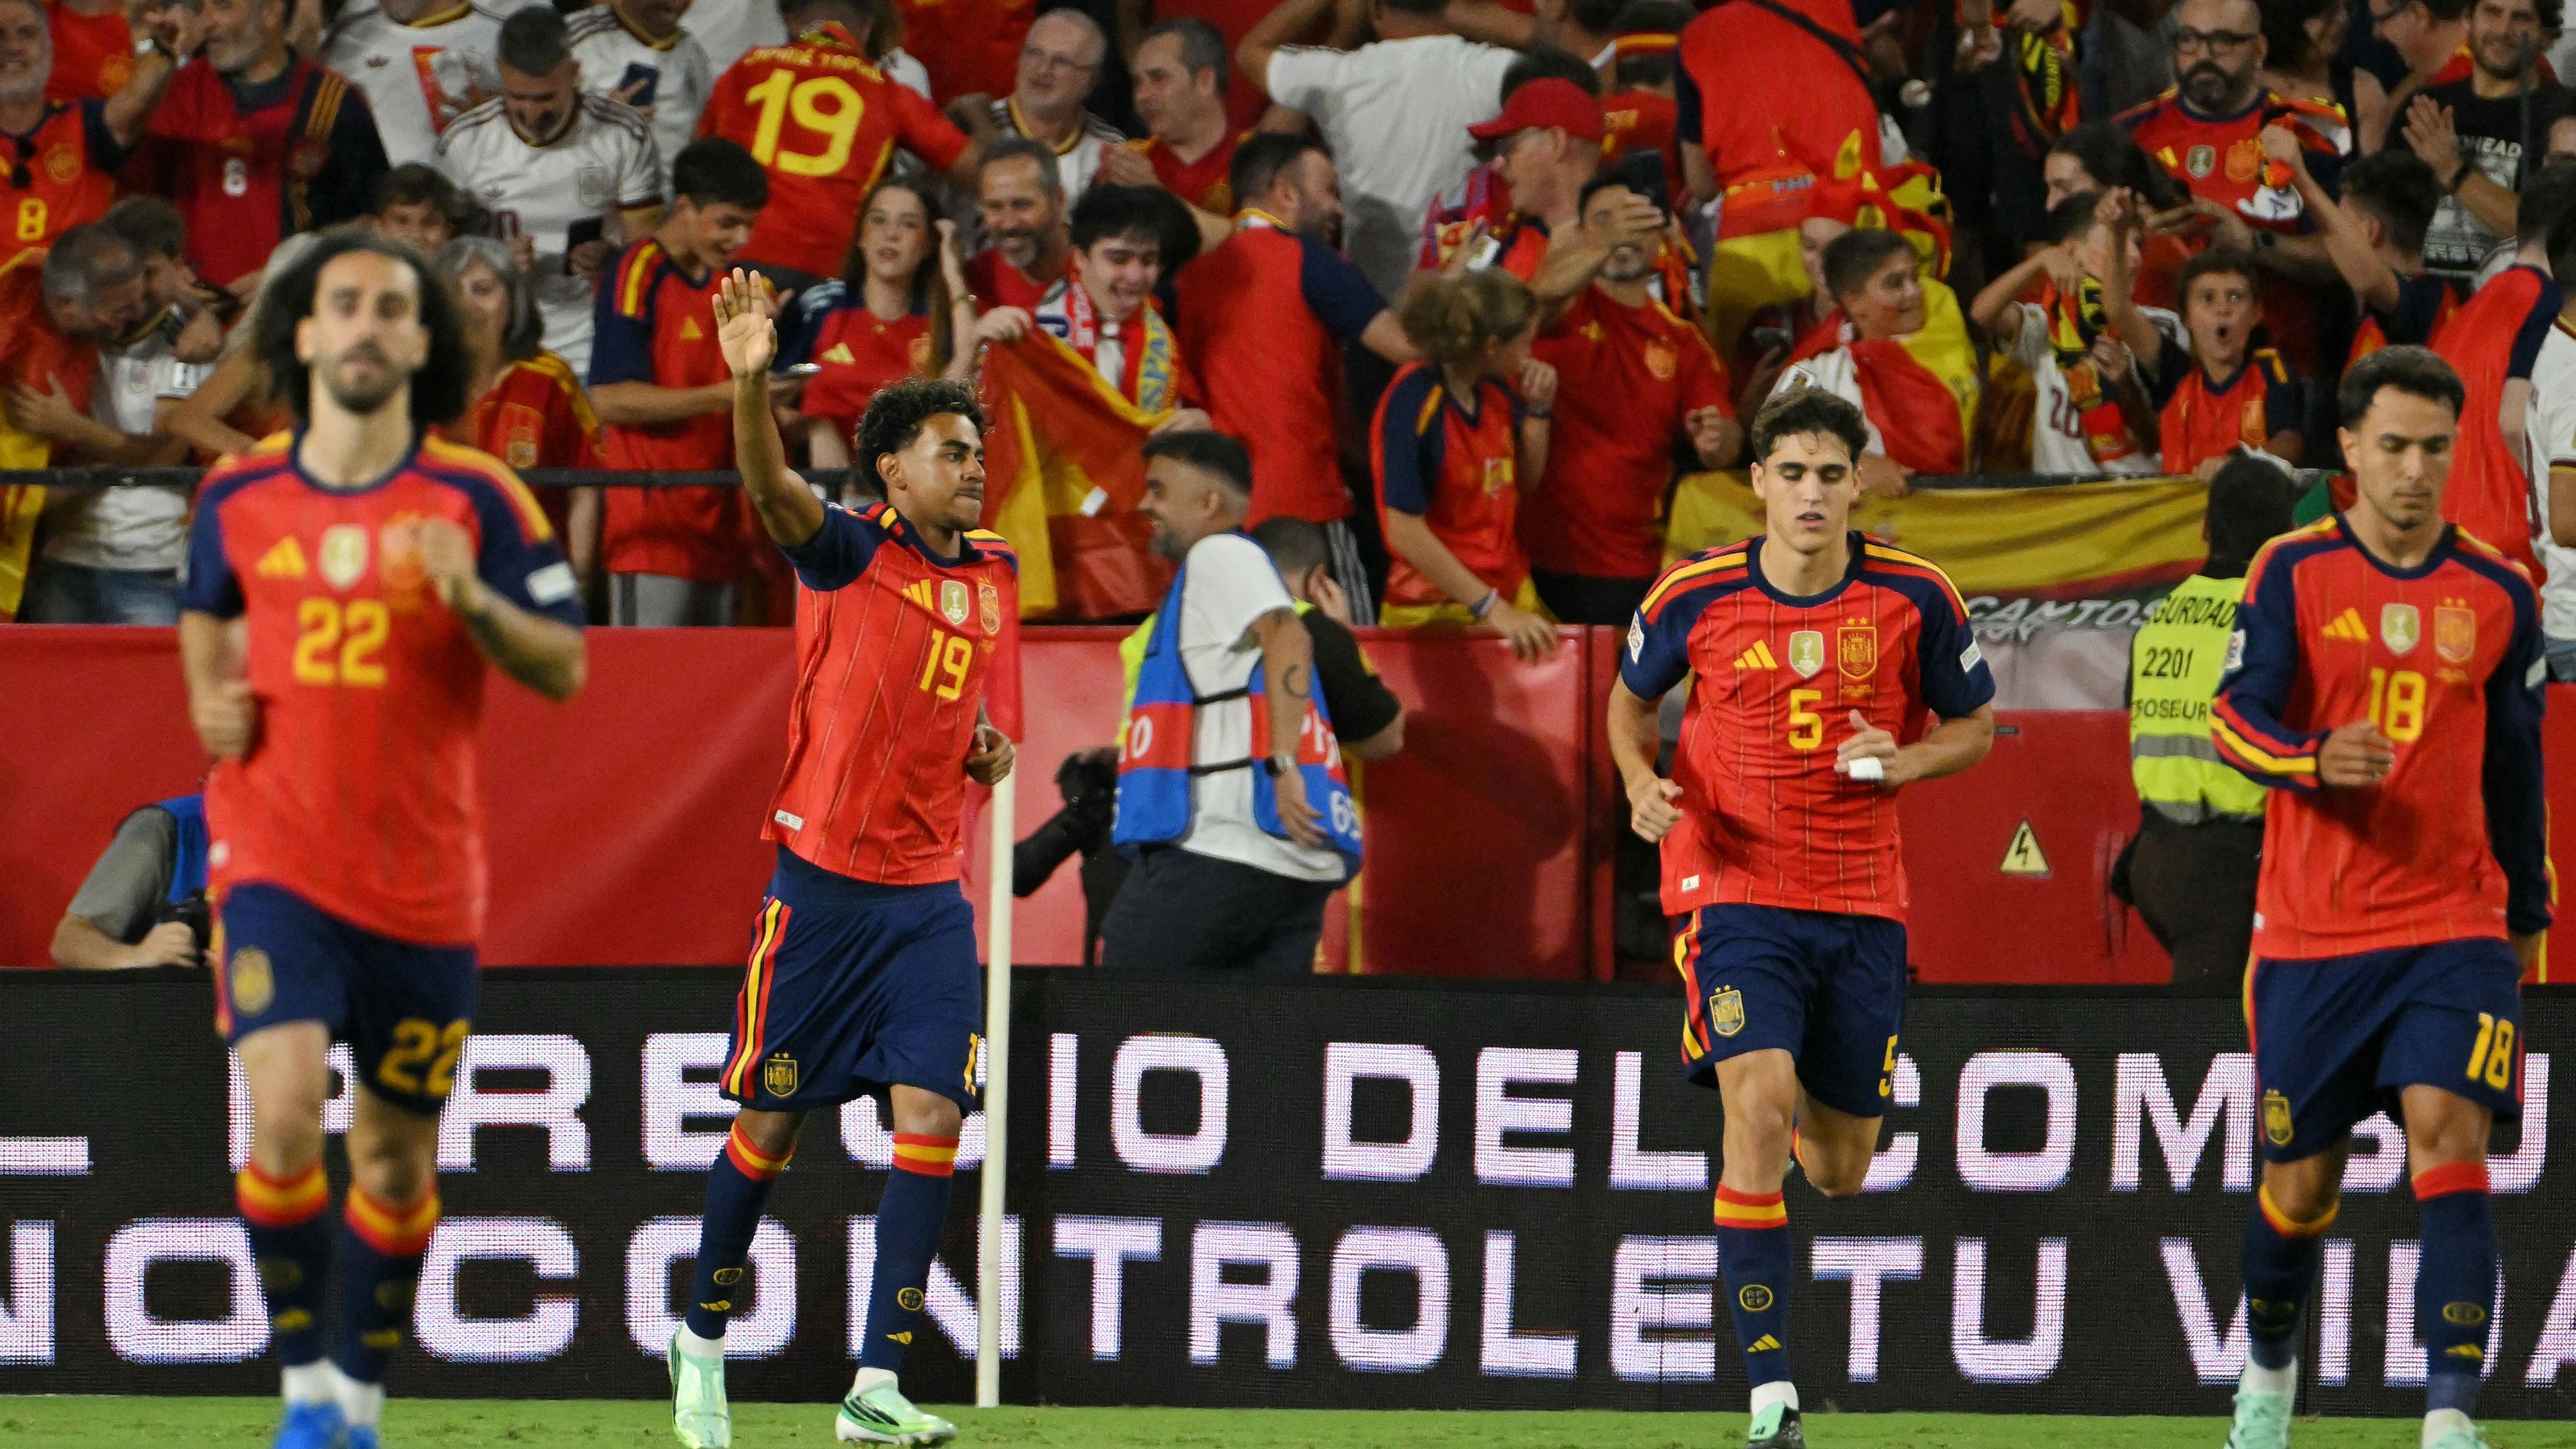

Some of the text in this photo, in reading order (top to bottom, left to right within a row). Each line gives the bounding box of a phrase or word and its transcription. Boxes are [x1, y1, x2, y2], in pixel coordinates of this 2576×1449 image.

[744, 68, 865, 176] 19
[17, 198, 47, 241] 8
[293, 598, 390, 687] 22
[919, 629, 972, 701] 19
[2142, 647, 2194, 678] 2201
[1788, 689, 1823, 750] 5
[2367, 667, 2426, 741] 18
[379, 1018, 469, 1097] 22
[1878, 1034, 1898, 1096] 5
[2465, 1011, 2515, 1090] 18
[1320, 1042, 1709, 1191] DEL
[413, 1214, 1718, 1383] CONTROLE
[1811, 1235, 2067, 1385] TU
